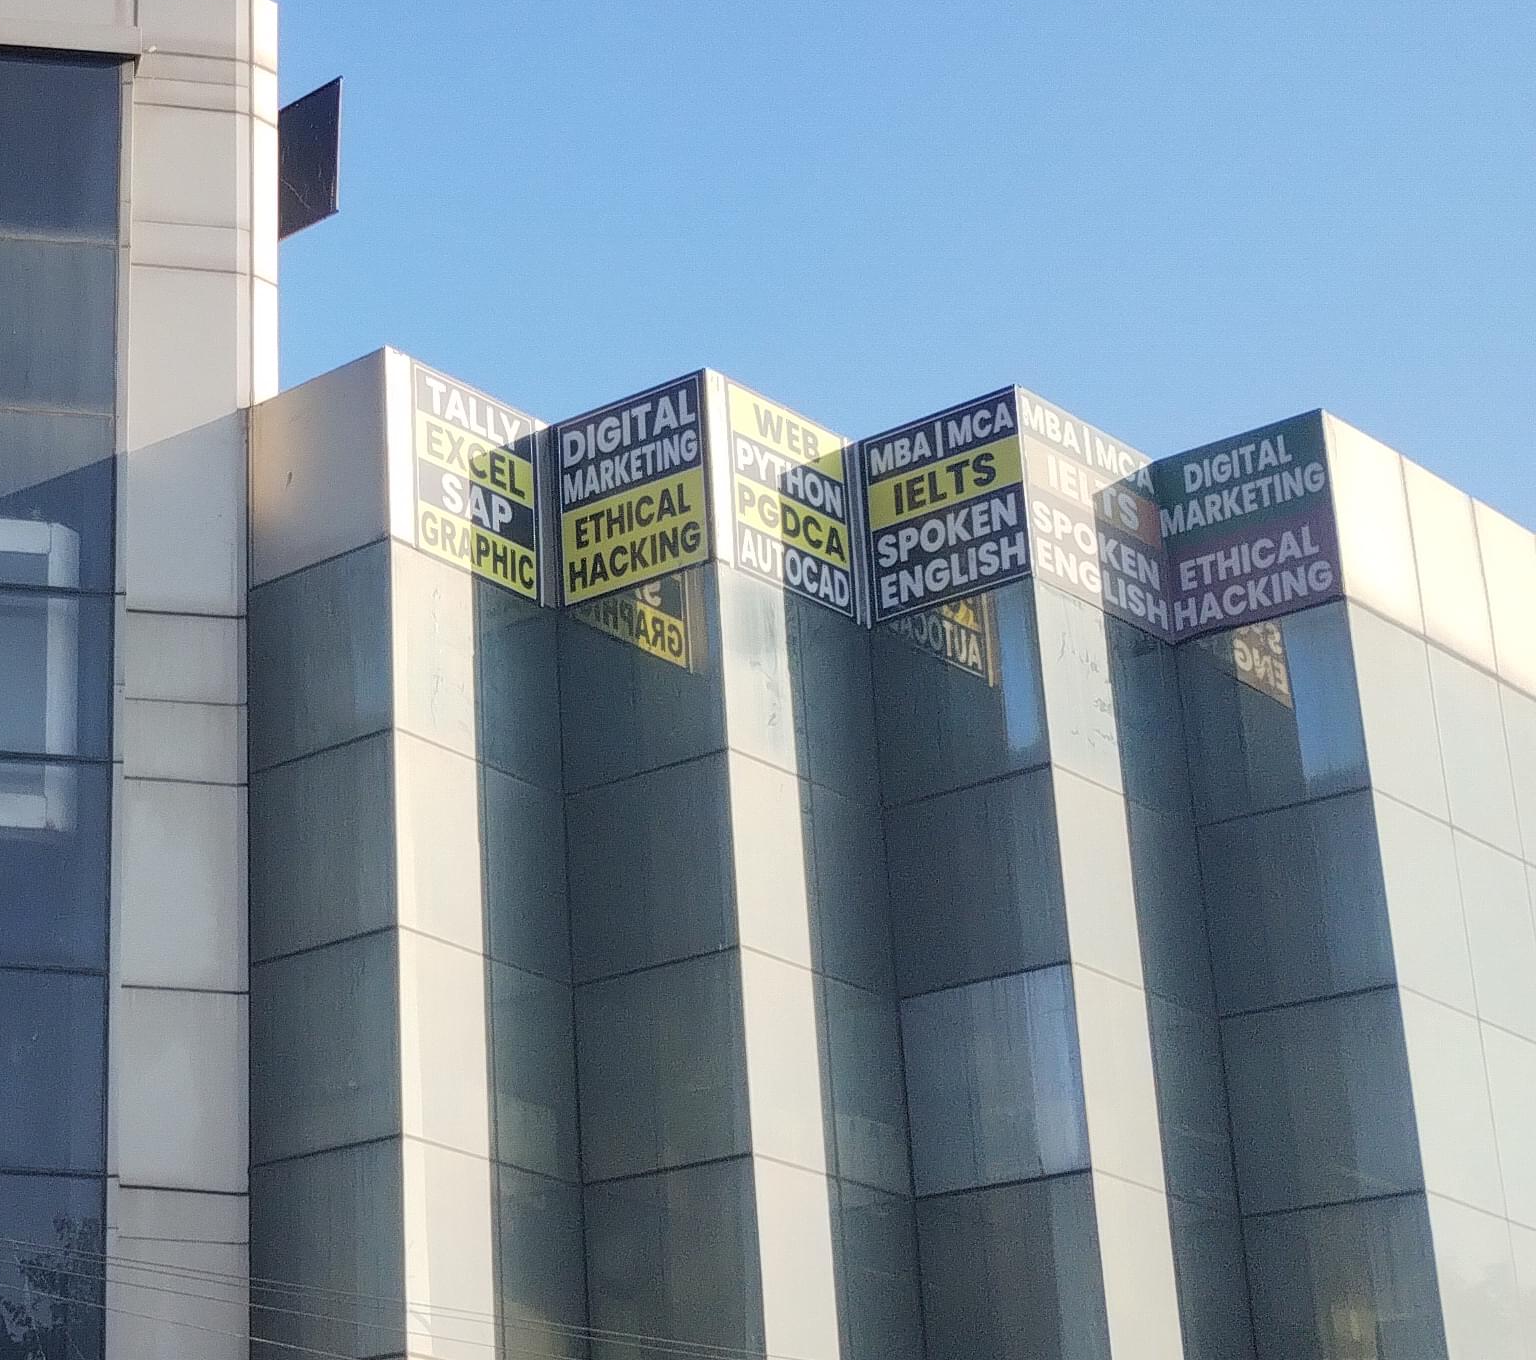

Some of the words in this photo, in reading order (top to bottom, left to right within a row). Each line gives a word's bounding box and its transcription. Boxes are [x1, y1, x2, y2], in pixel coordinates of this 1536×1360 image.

[426, 376, 520, 455] TALLY
[564, 390, 696, 466] DIGITAL
[753, 403, 820, 463] WEB
[426, 420, 526, 499] EXCEL
[564, 430, 697, 506] MARKETING
[734, 438, 843, 521] PYTHON
[893, 451, 997, 516] IELTS
[1047, 455, 1140, 531] IELTS
[1183, 433, 1292, 494] DIGITAL
[441, 472, 512, 532] SAP
[575, 483, 691, 550] ETHICAL
[738, 484, 846, 563] PGDCA
[877, 493, 1018, 569] SPOKEN
[1160, 462, 1325, 537] MARKETING
[421, 511, 534, 589] GRAPHIC
[569, 521, 702, 593] HACKING
[741, 528, 851, 608] AUTOCAD
[881, 533, 1026, 610] ENGLISH
[1032, 500, 1161, 591] SPOKEN
[1036, 536, 1169, 631] ENGLISH
[1179, 520, 1320, 593] ETHICAL
[1174, 560, 1333, 632] HACKING
